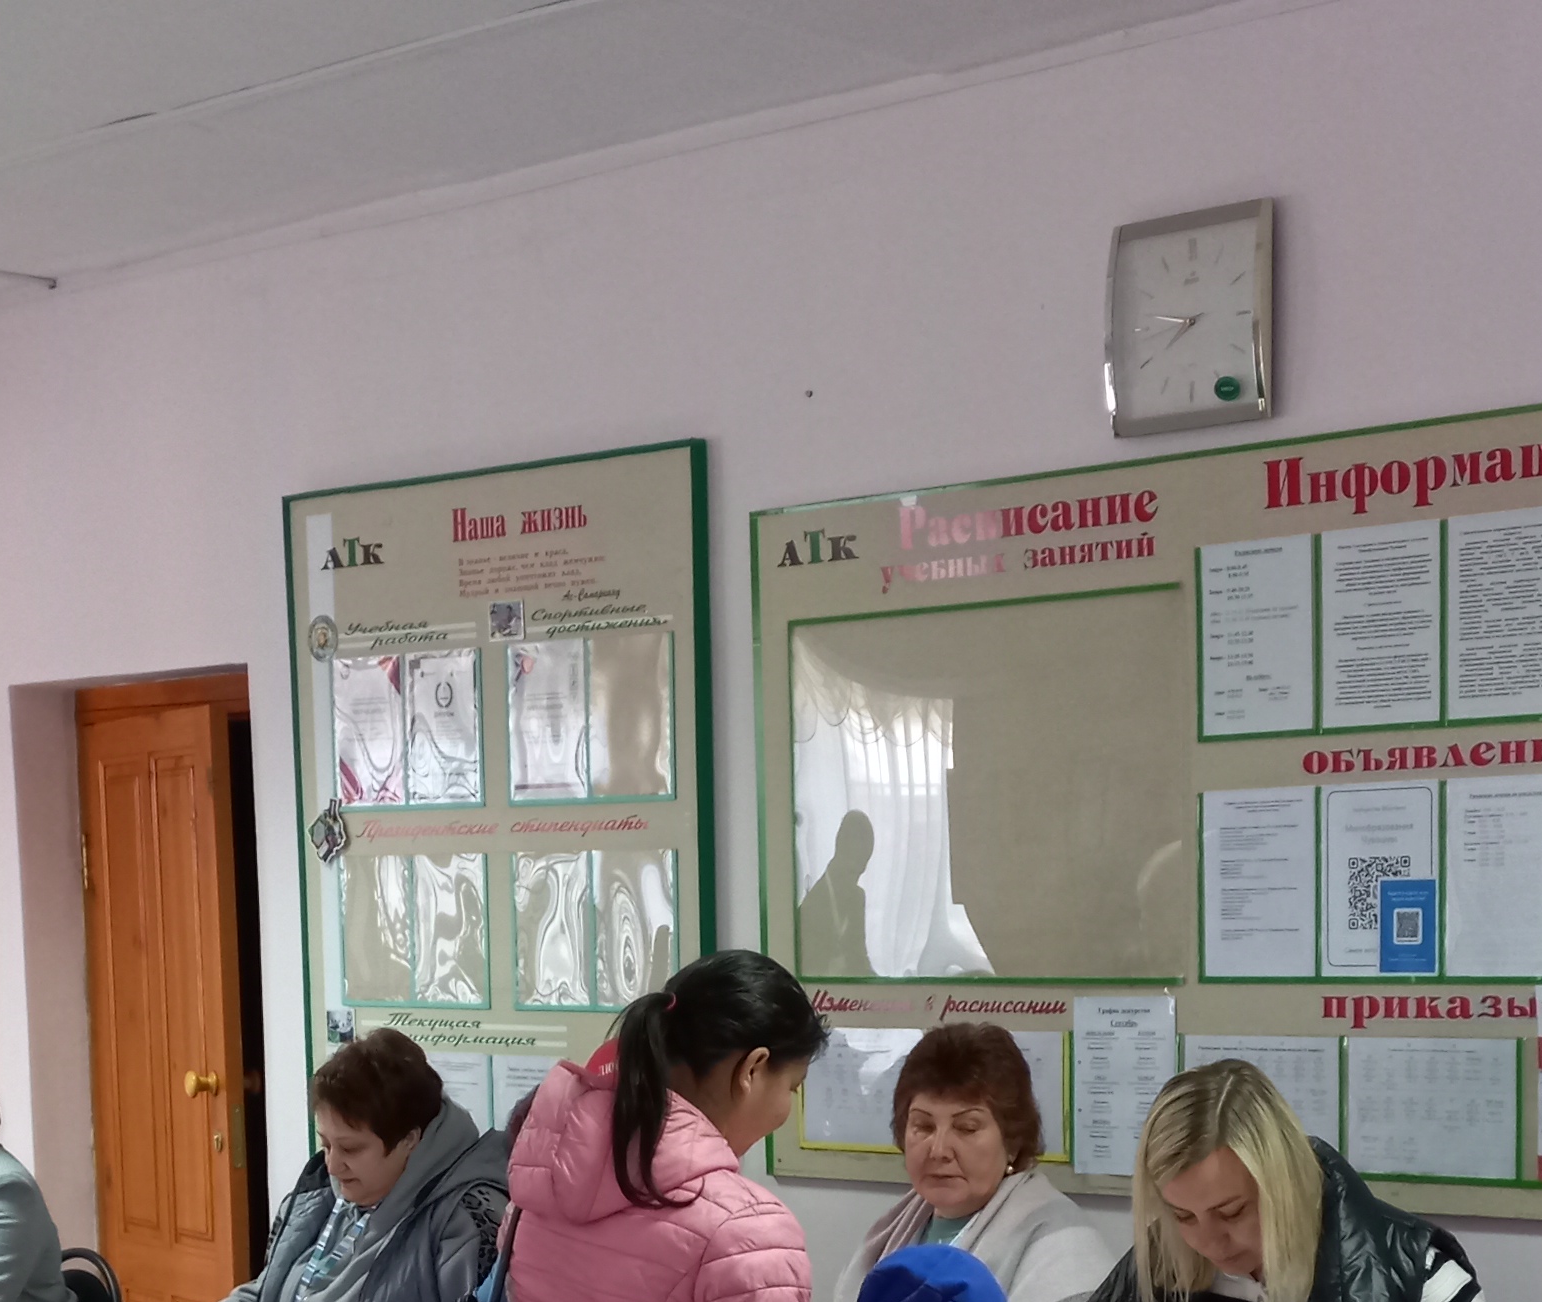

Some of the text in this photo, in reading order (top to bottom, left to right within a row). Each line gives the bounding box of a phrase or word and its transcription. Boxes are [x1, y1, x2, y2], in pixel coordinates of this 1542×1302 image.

[452, 504, 588, 543] Наша жизнь
[897, 488, 1160, 552] Расписание
[320, 536, 385, 571] АТК
[776, 527, 860, 569] АТК
[1023, 531, 1157, 572] занятий
[344, 619, 429, 636] Учебная
[370, 630, 449, 650] работа
[356, 814, 649, 842] Президентские стипендиаты
[383, 1011, 482, 1031] Текущая
[810, 988, 914, 1015] Измен
[939, 994, 1068, 1022] расписании
[1321, 994, 1537, 1030] приказы
[409, 1032, 537, 1047] информация
